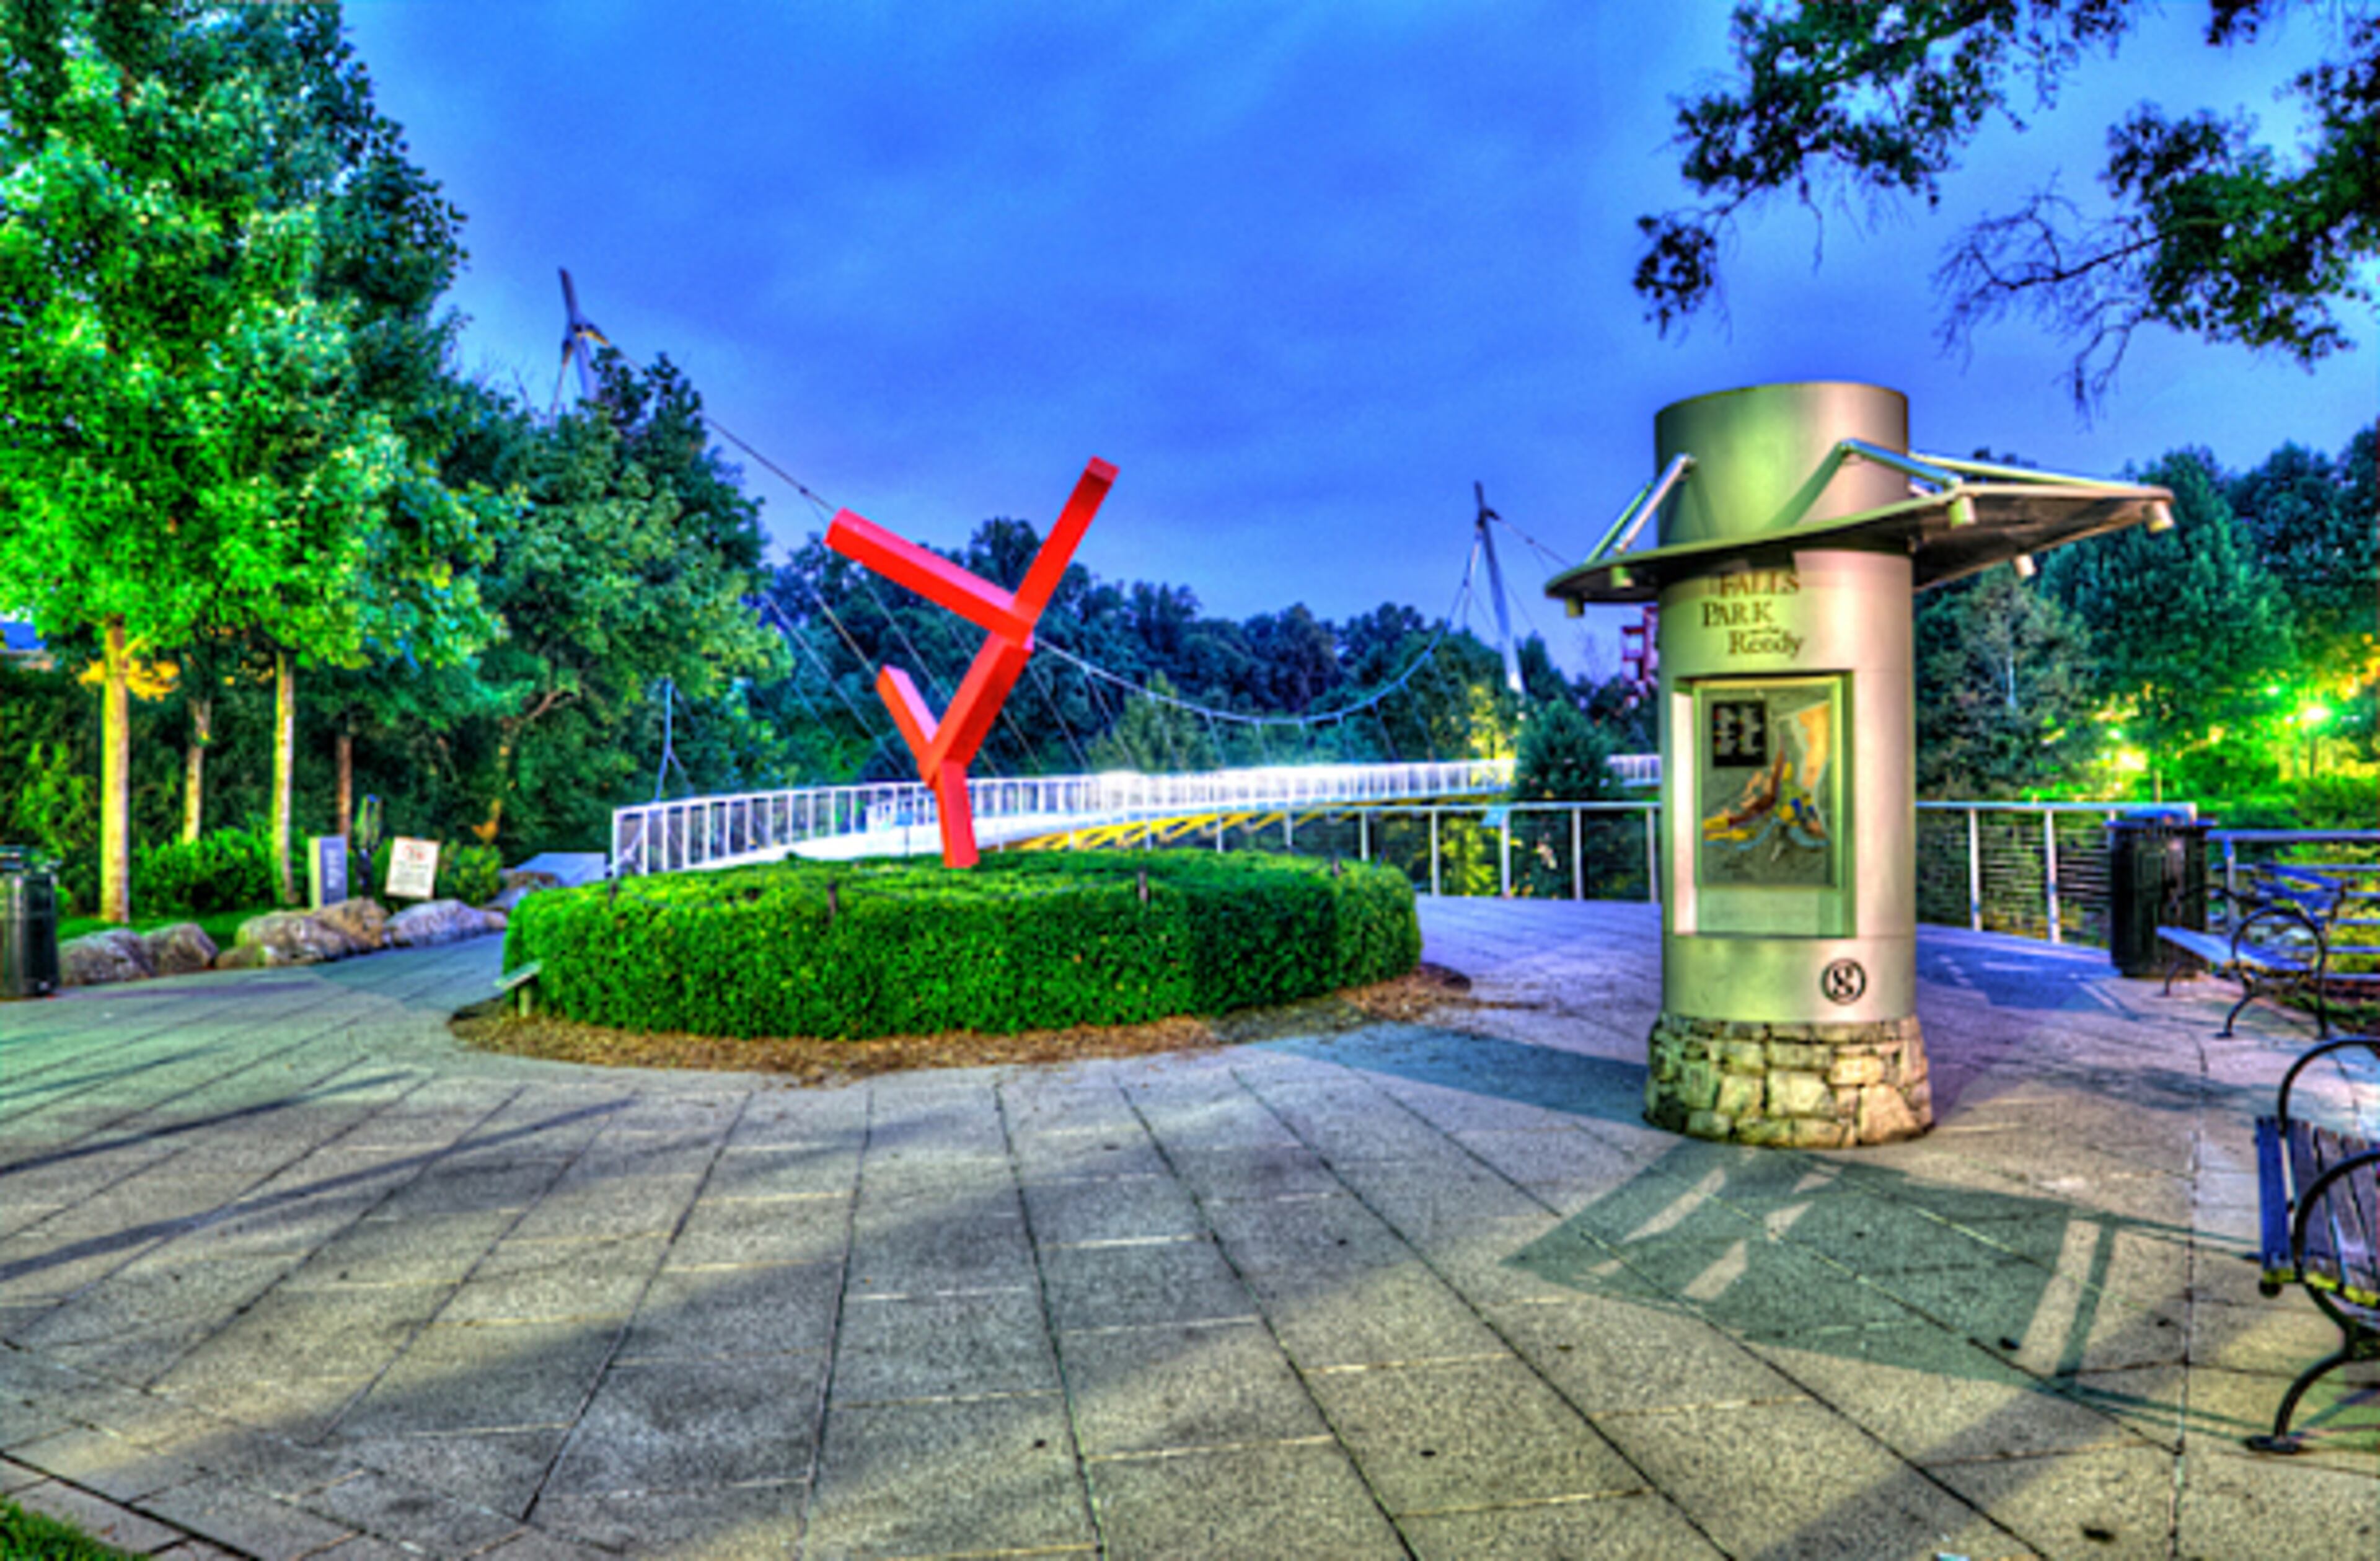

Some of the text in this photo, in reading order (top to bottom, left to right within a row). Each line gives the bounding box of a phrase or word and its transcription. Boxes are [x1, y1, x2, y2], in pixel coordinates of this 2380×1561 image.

[1719, 570, 1800, 596] FALLS
[1702, 601, 1774, 627] PARK
[1729, 630, 1805, 659] Reedy
